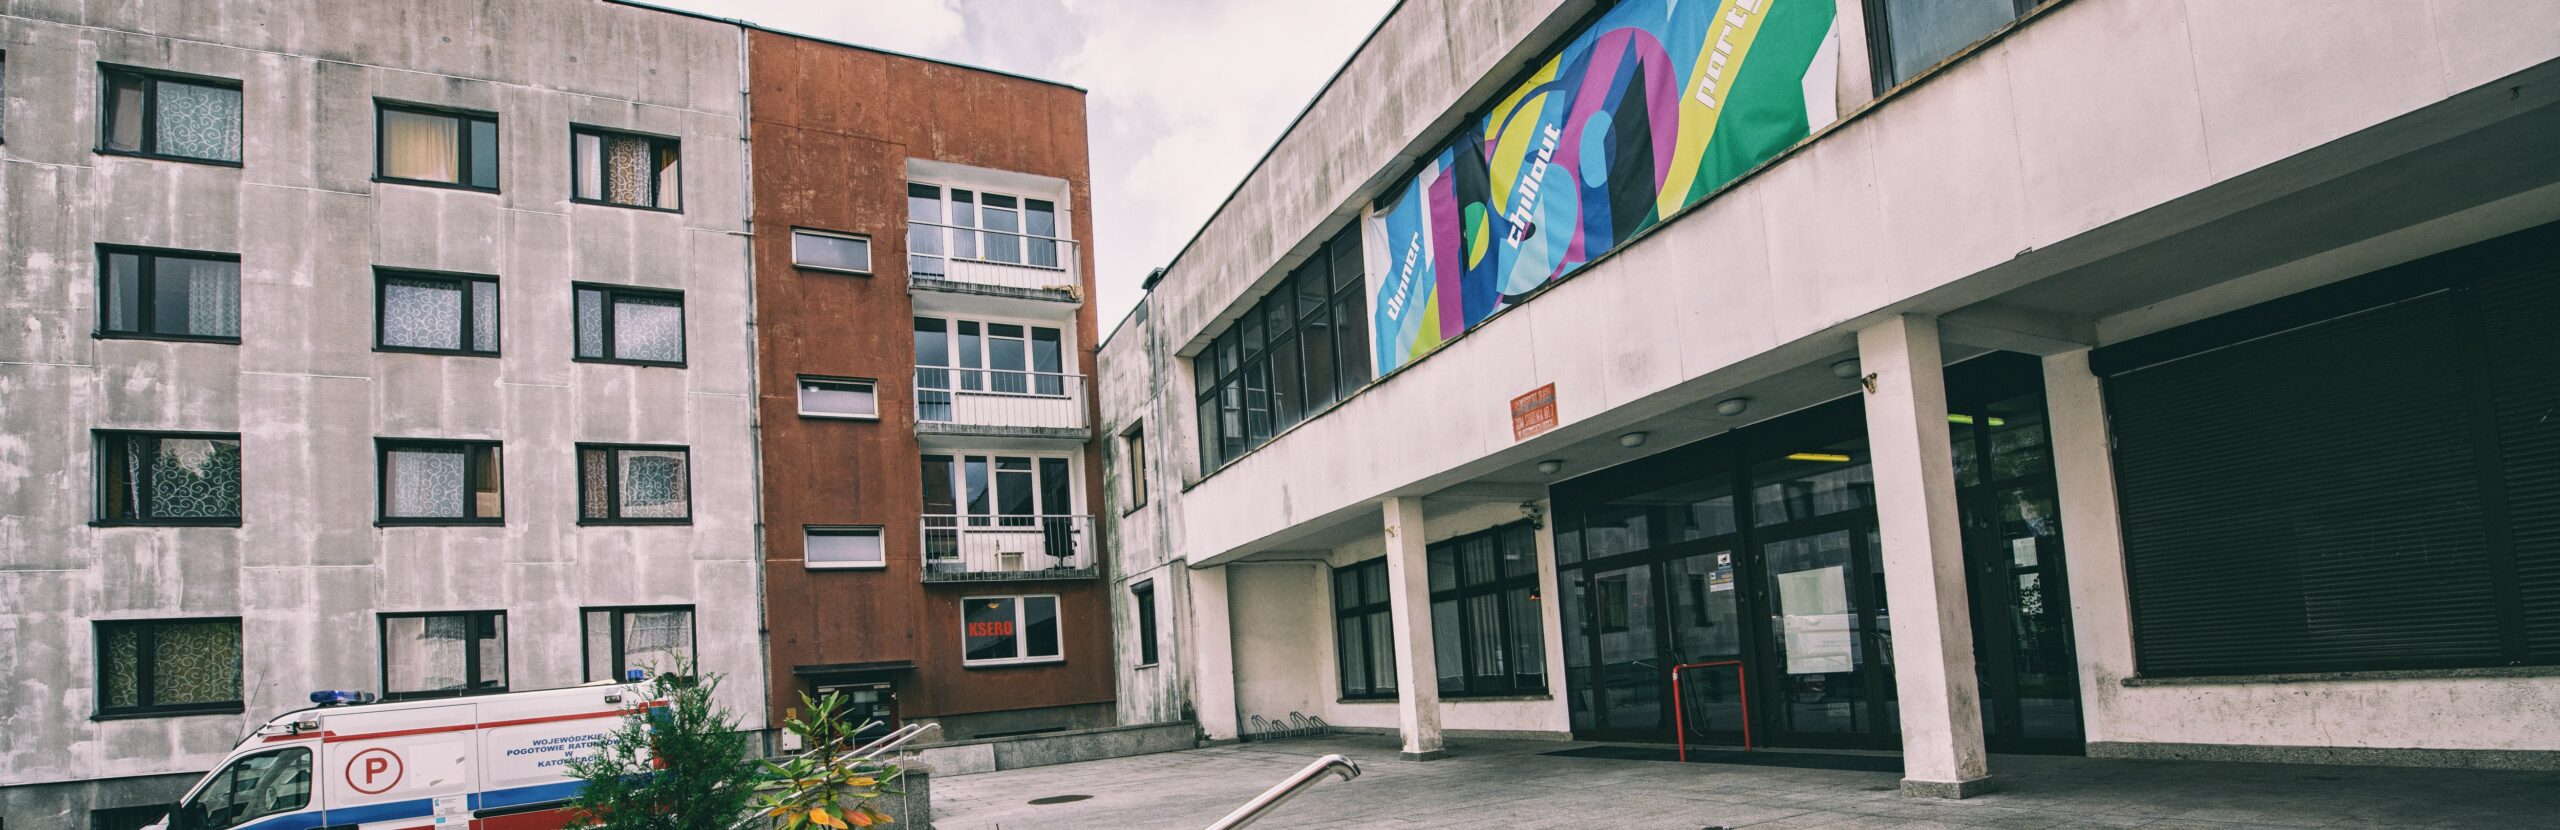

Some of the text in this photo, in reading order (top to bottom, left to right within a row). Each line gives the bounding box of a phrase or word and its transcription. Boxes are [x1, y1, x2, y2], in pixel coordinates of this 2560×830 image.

[1507, 122, 1560, 250] chillout
[1387, 231, 1420, 321] dinner
[968, 621, 1013, 637] KSERO
[506, 745, 565, 756] POGOTOWIE
[365, 757, 388, 784] P
